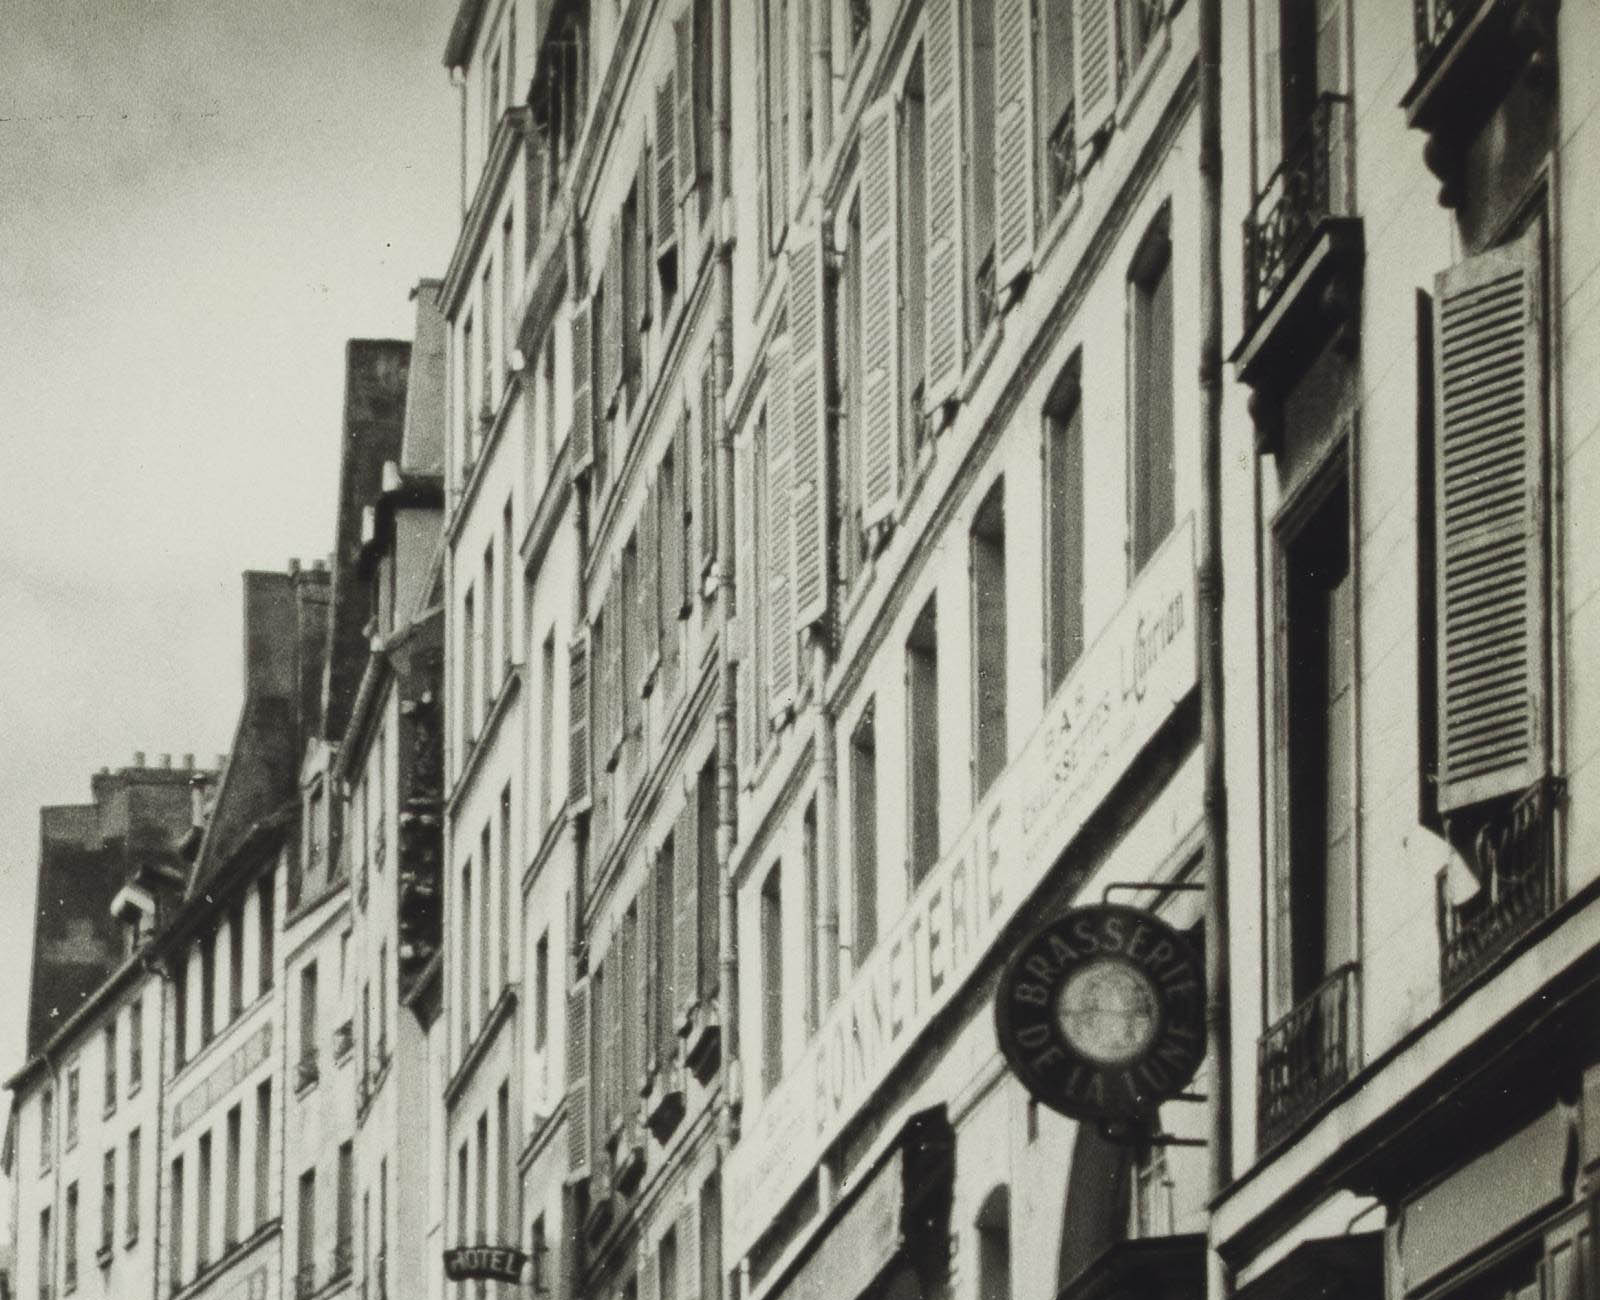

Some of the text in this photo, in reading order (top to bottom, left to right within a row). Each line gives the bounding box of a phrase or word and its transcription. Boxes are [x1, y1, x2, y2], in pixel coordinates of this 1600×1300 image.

[1014, 916, 1197, 1006] BRASSERIE
[1016, 1023, 1064, 1074] DE
[450, 1248, 516, 1275] HOTEL
